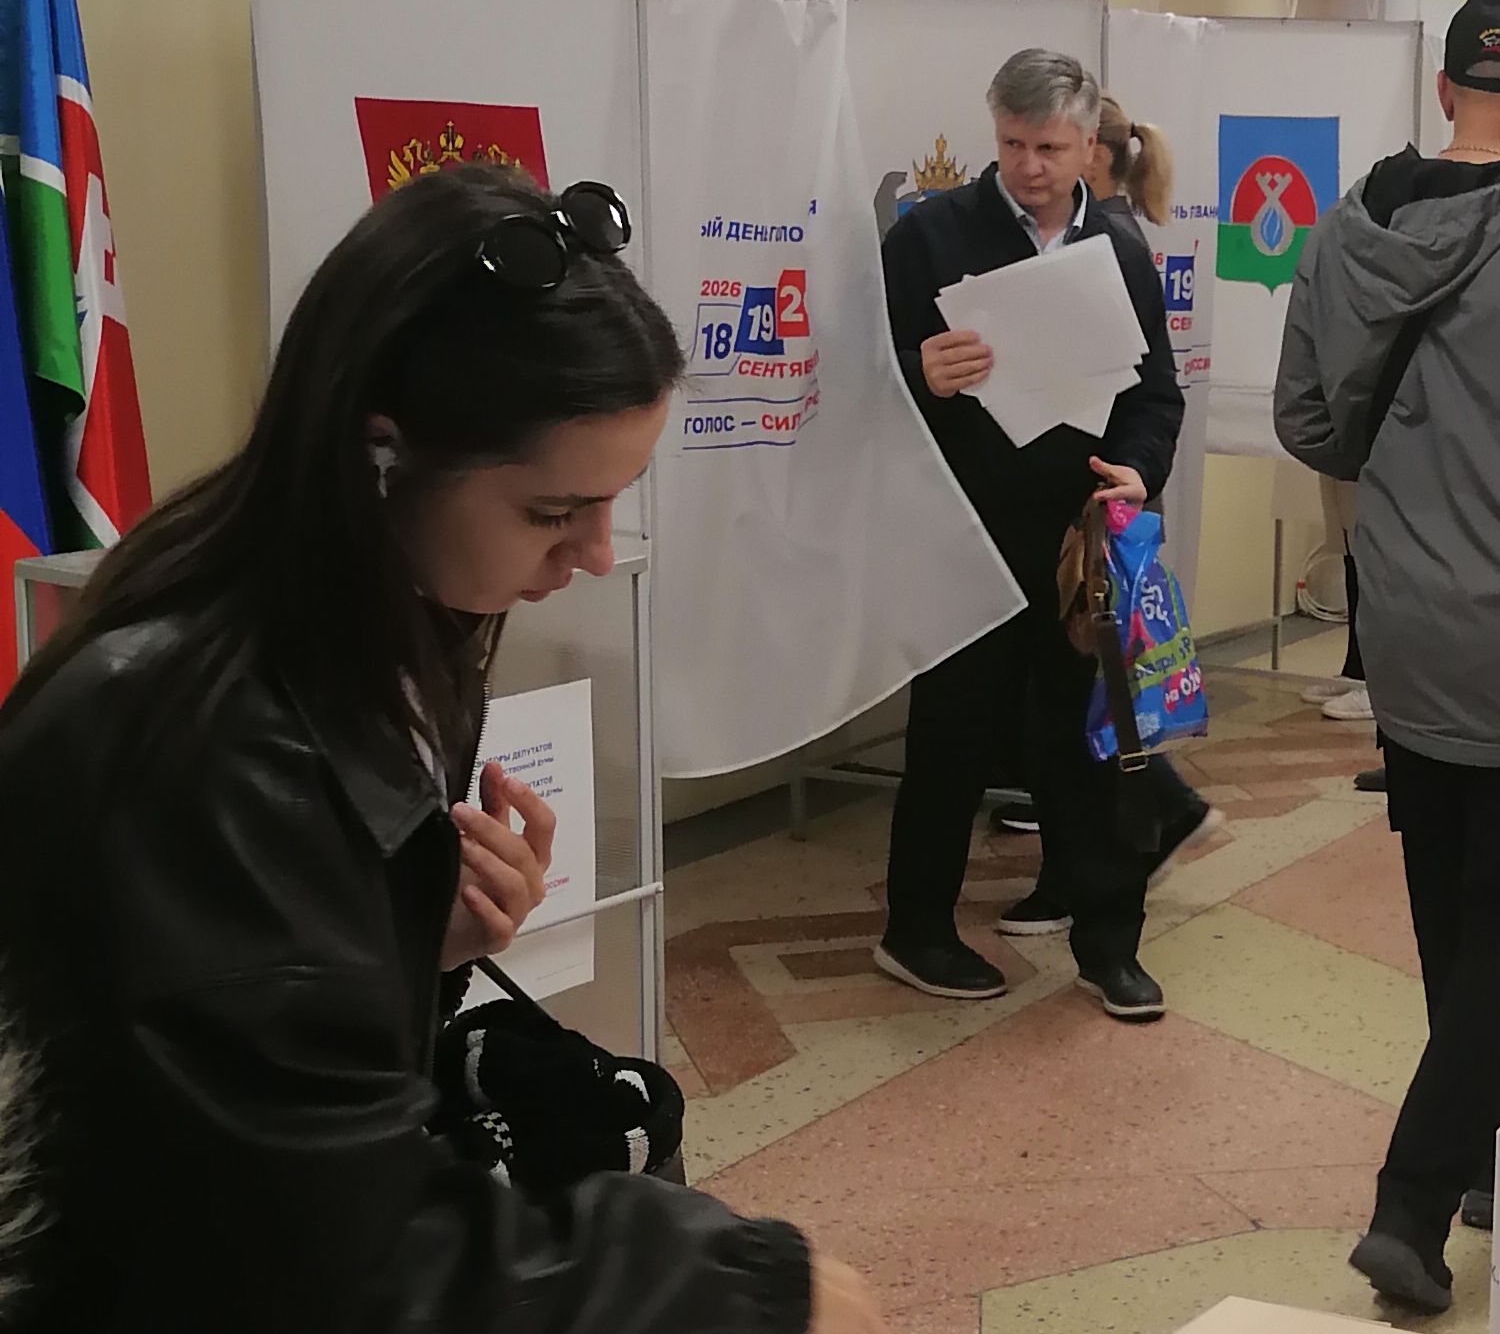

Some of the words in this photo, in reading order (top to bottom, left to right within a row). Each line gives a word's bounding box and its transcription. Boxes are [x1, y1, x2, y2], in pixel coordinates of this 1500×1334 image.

[700, 279, 742, 298] 2026
[1170, 268, 1194, 301] 19
[702, 322, 733, 360] 18
[747, 304, 775, 342] 19
[684, 415, 735, 435] ГОЛОС
